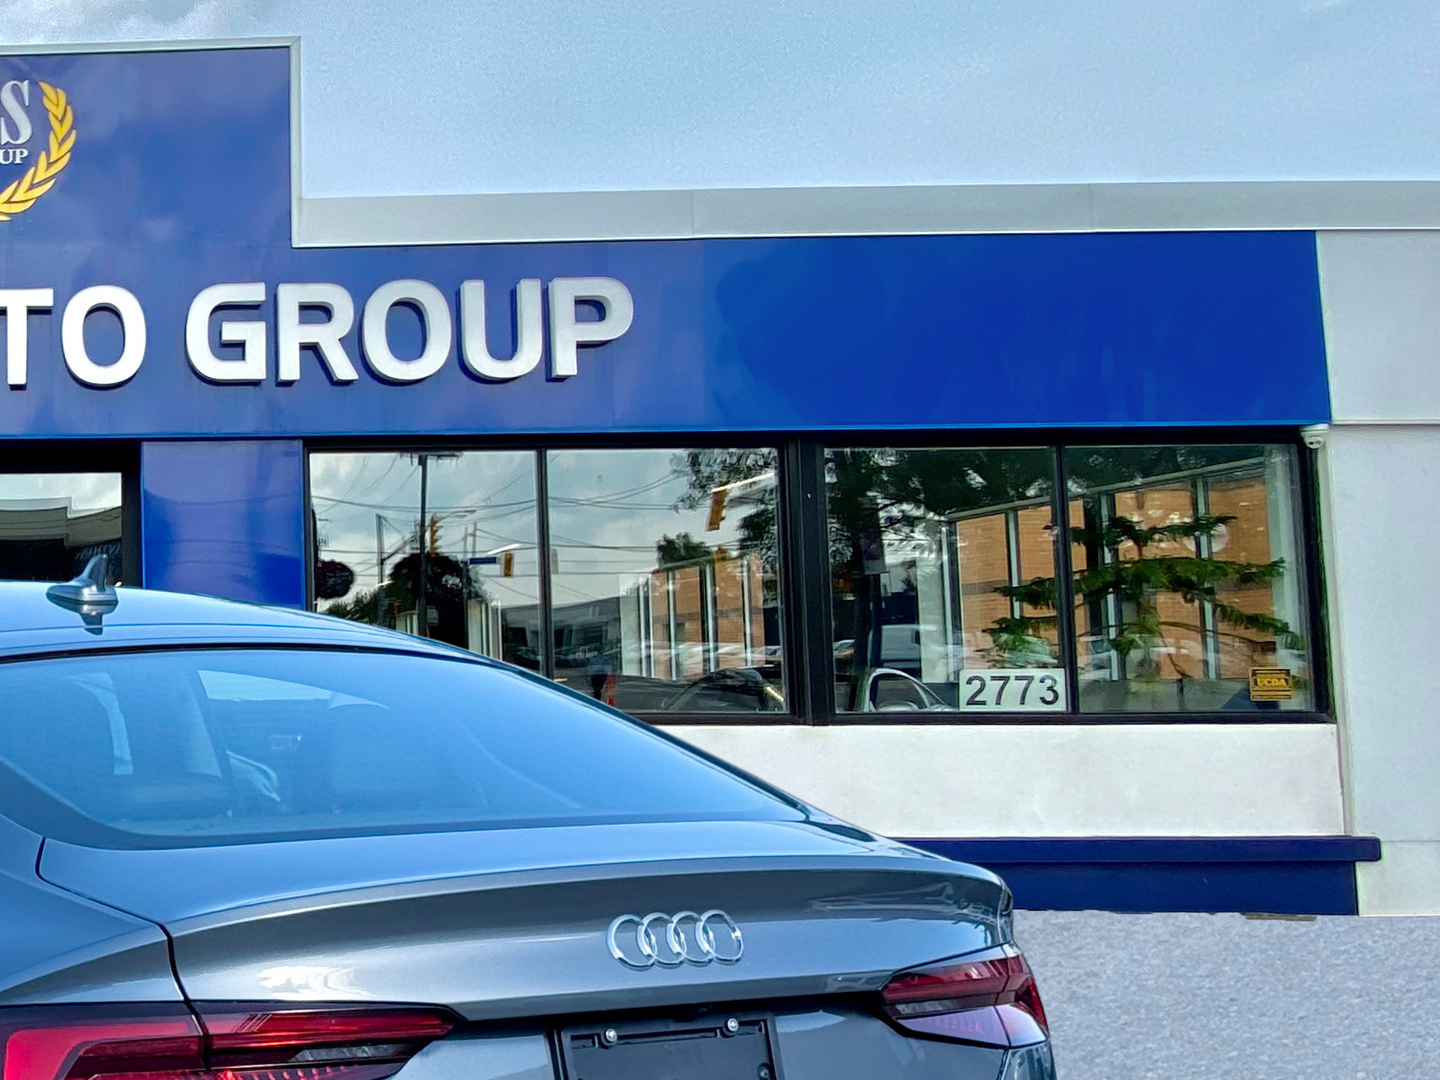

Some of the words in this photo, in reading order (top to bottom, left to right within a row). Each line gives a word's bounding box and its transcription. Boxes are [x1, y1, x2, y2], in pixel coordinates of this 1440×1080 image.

[185, 277, 634, 383] GROUP
[965, 674, 1060, 707] 2773
[1257, 678, 1288, 686] UCDA
